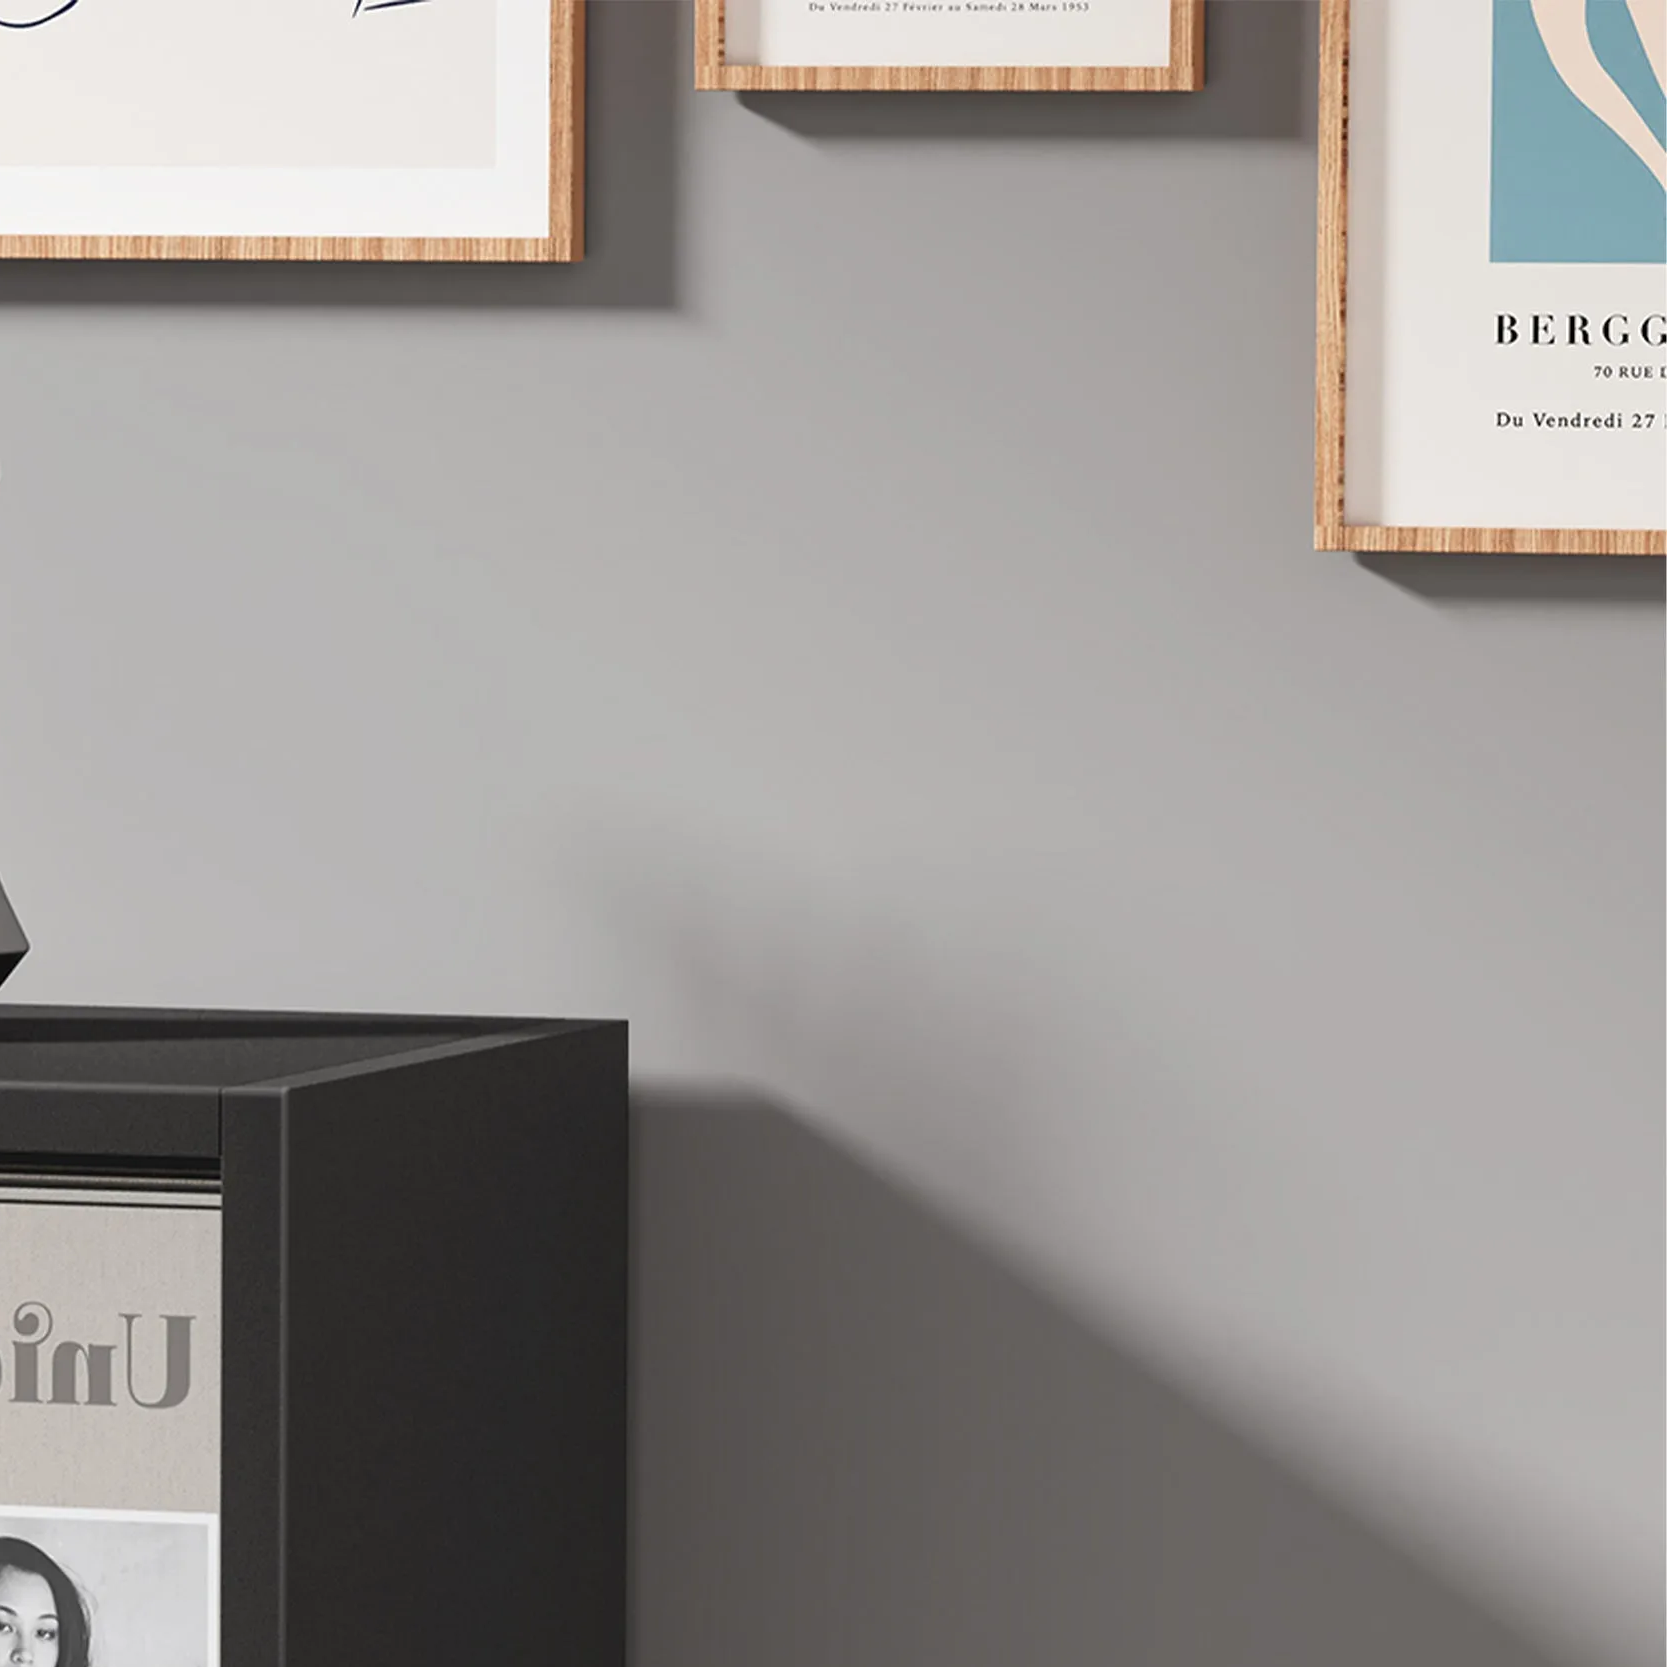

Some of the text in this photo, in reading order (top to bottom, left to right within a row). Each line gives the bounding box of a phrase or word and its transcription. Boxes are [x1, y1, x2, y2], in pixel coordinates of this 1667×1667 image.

[808, 2, 825, 12] Du
[830, 2, 881, 12] Vendredi
[884, 2, 898, 12] 27
[947, 4, 962, 12] au
[965, 2, 1007, 12] Samedi
[1011, 2, 1025, 12] 28
[1029, 2, 1058, 12] Mars
[1062, 2, 1090, 12] 1953
[1593, 365, 1614, 379] 70
[1618, 365, 1654, 379] RUE
[1496, 412, 1524, 428] Du
[1533, 412, 1623, 429] Vendredi
[1631, 413, 1656, 429] 27
